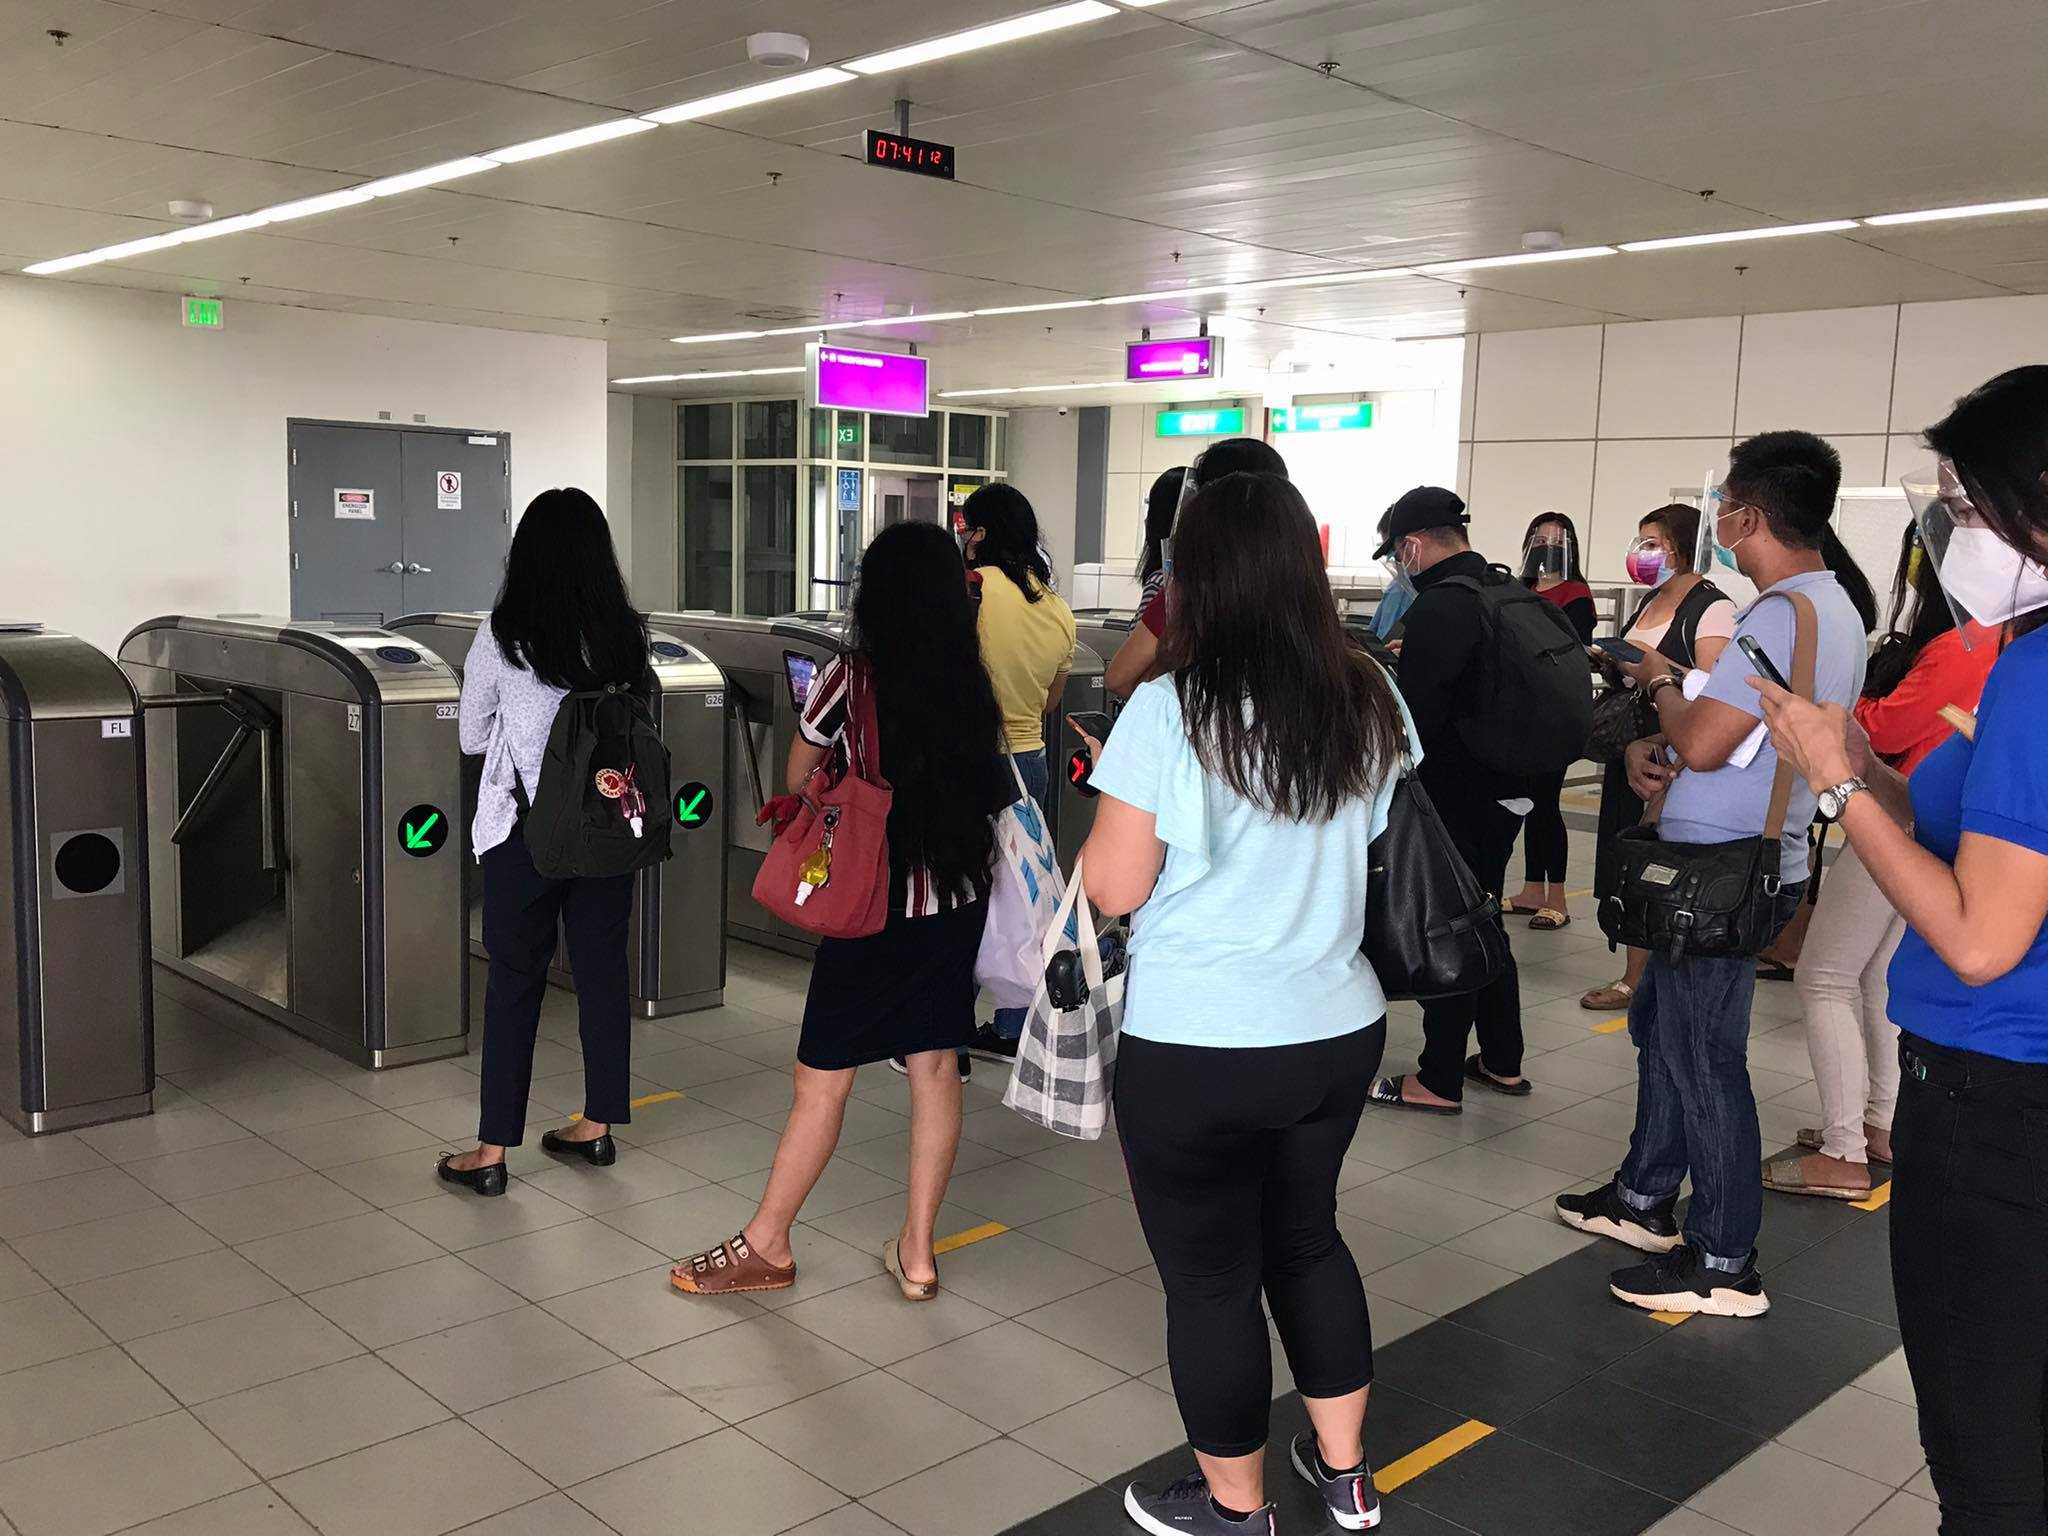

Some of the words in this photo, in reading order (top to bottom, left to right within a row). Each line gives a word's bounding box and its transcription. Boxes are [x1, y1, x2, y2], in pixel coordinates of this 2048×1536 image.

[876, 139, 923, 164] 07:41
[706, 695, 723, 704] G26
[436, 705, 459, 718] G27
[111, 722, 126, 734] FL
